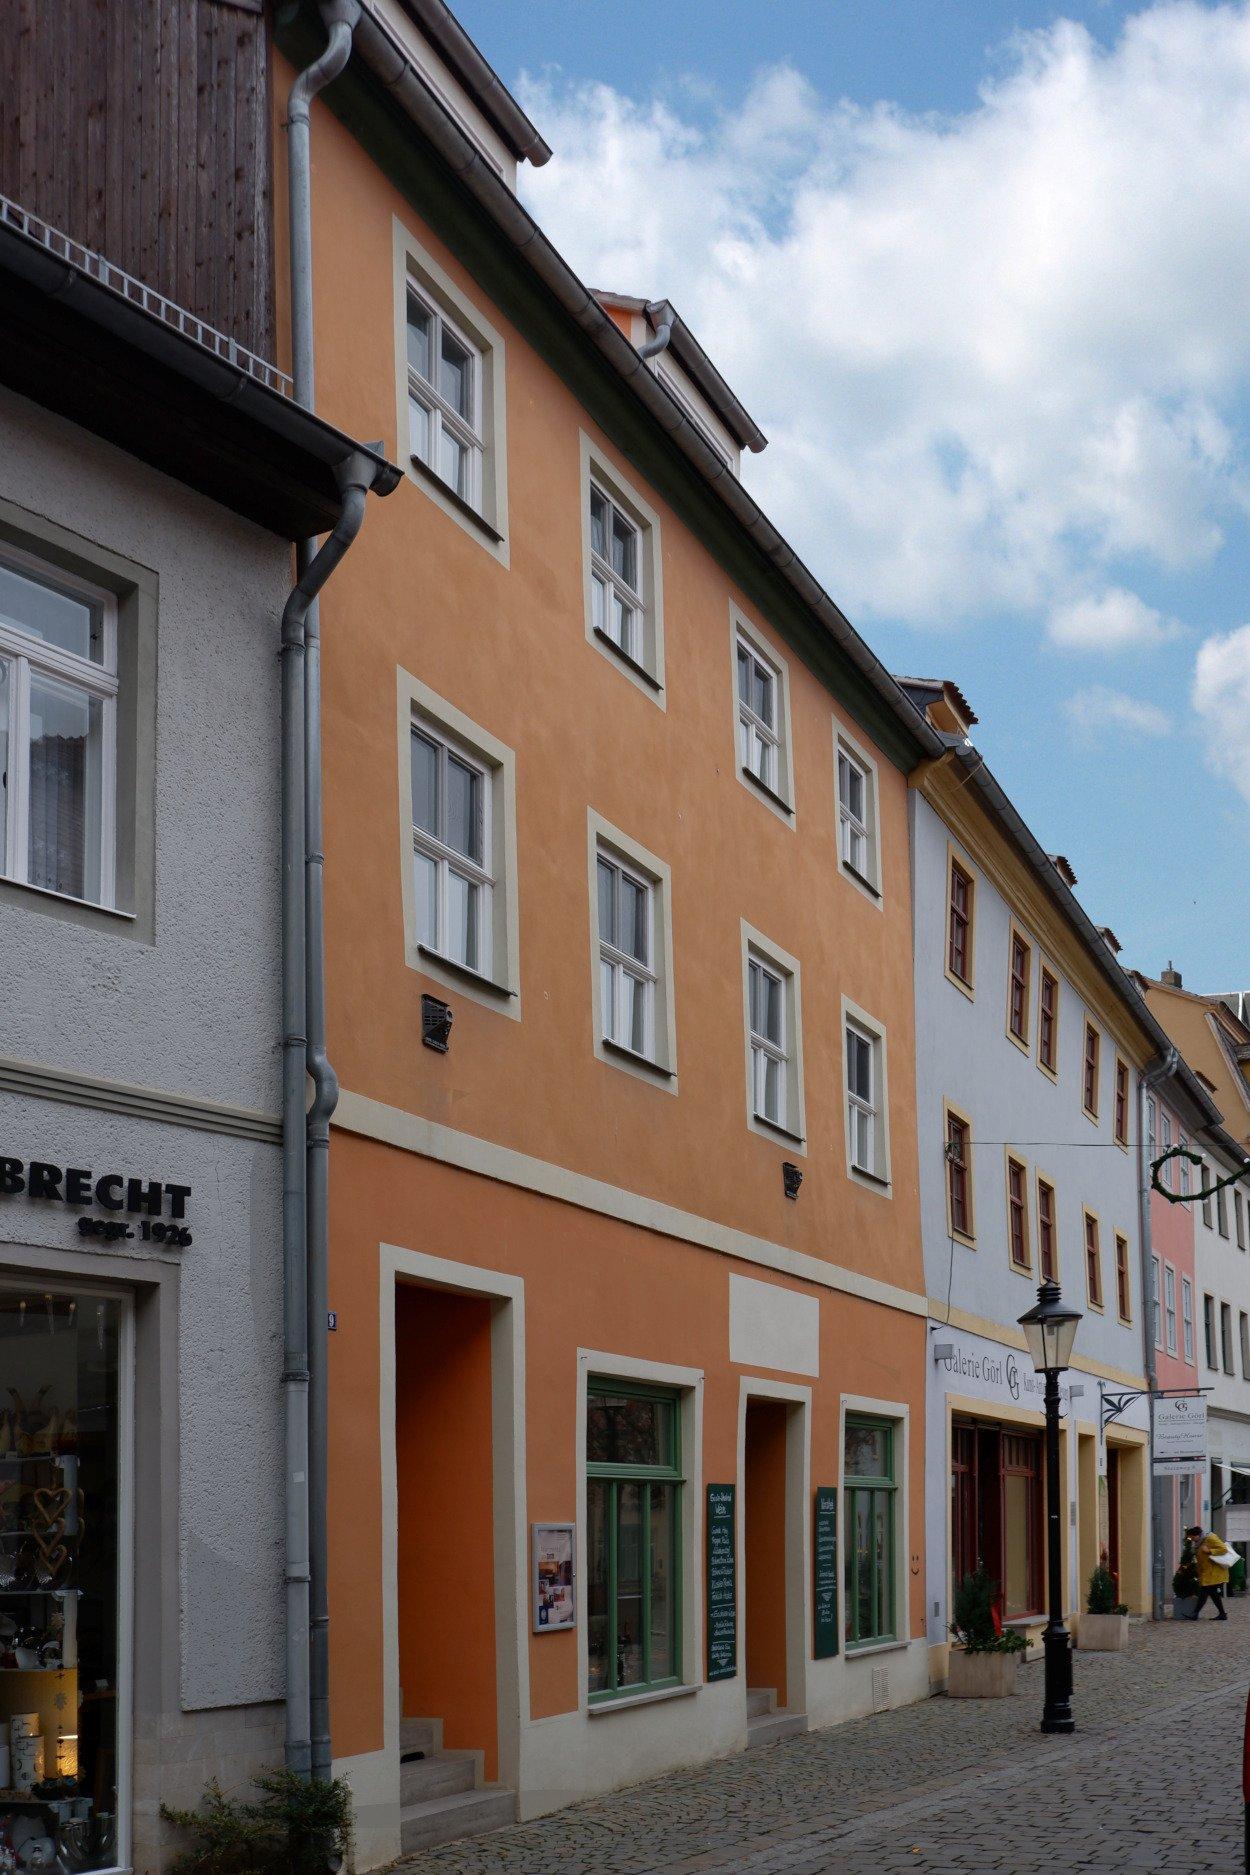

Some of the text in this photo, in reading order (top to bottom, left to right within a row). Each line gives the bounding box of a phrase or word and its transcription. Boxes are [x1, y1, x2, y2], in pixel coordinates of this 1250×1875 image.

[0, 1156, 192, 1219] BRECHT
[78, 1216, 193, 1246] gegr. 1926
[982, 1356, 1003, 1385] Görl
[1158, 1412, 1187, 1421] Galerie
